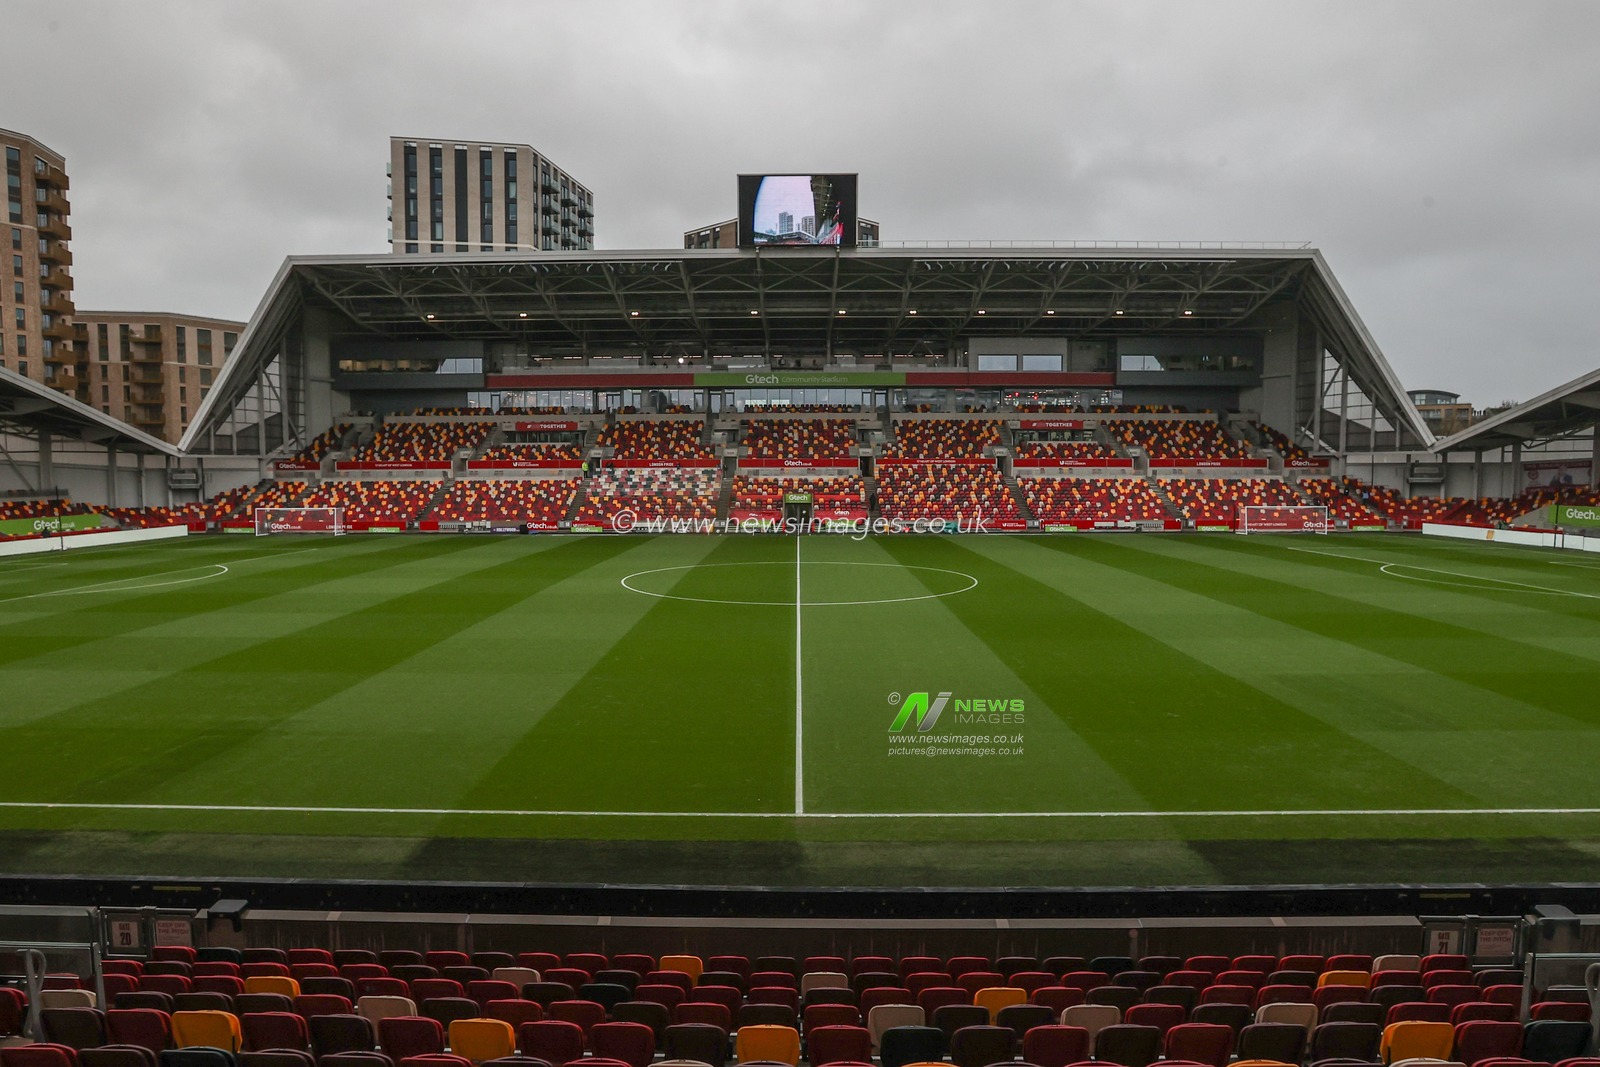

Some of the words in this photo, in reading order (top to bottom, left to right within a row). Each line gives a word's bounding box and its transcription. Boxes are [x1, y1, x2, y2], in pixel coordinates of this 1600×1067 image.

[746, 374, 779, 384] Gtech
[118, 923, 130, 931] GATE
[120, 932, 131, 946] 20
[1438, 932, 1450, 940] GATE
[1438, 941, 1449, 955] 21
